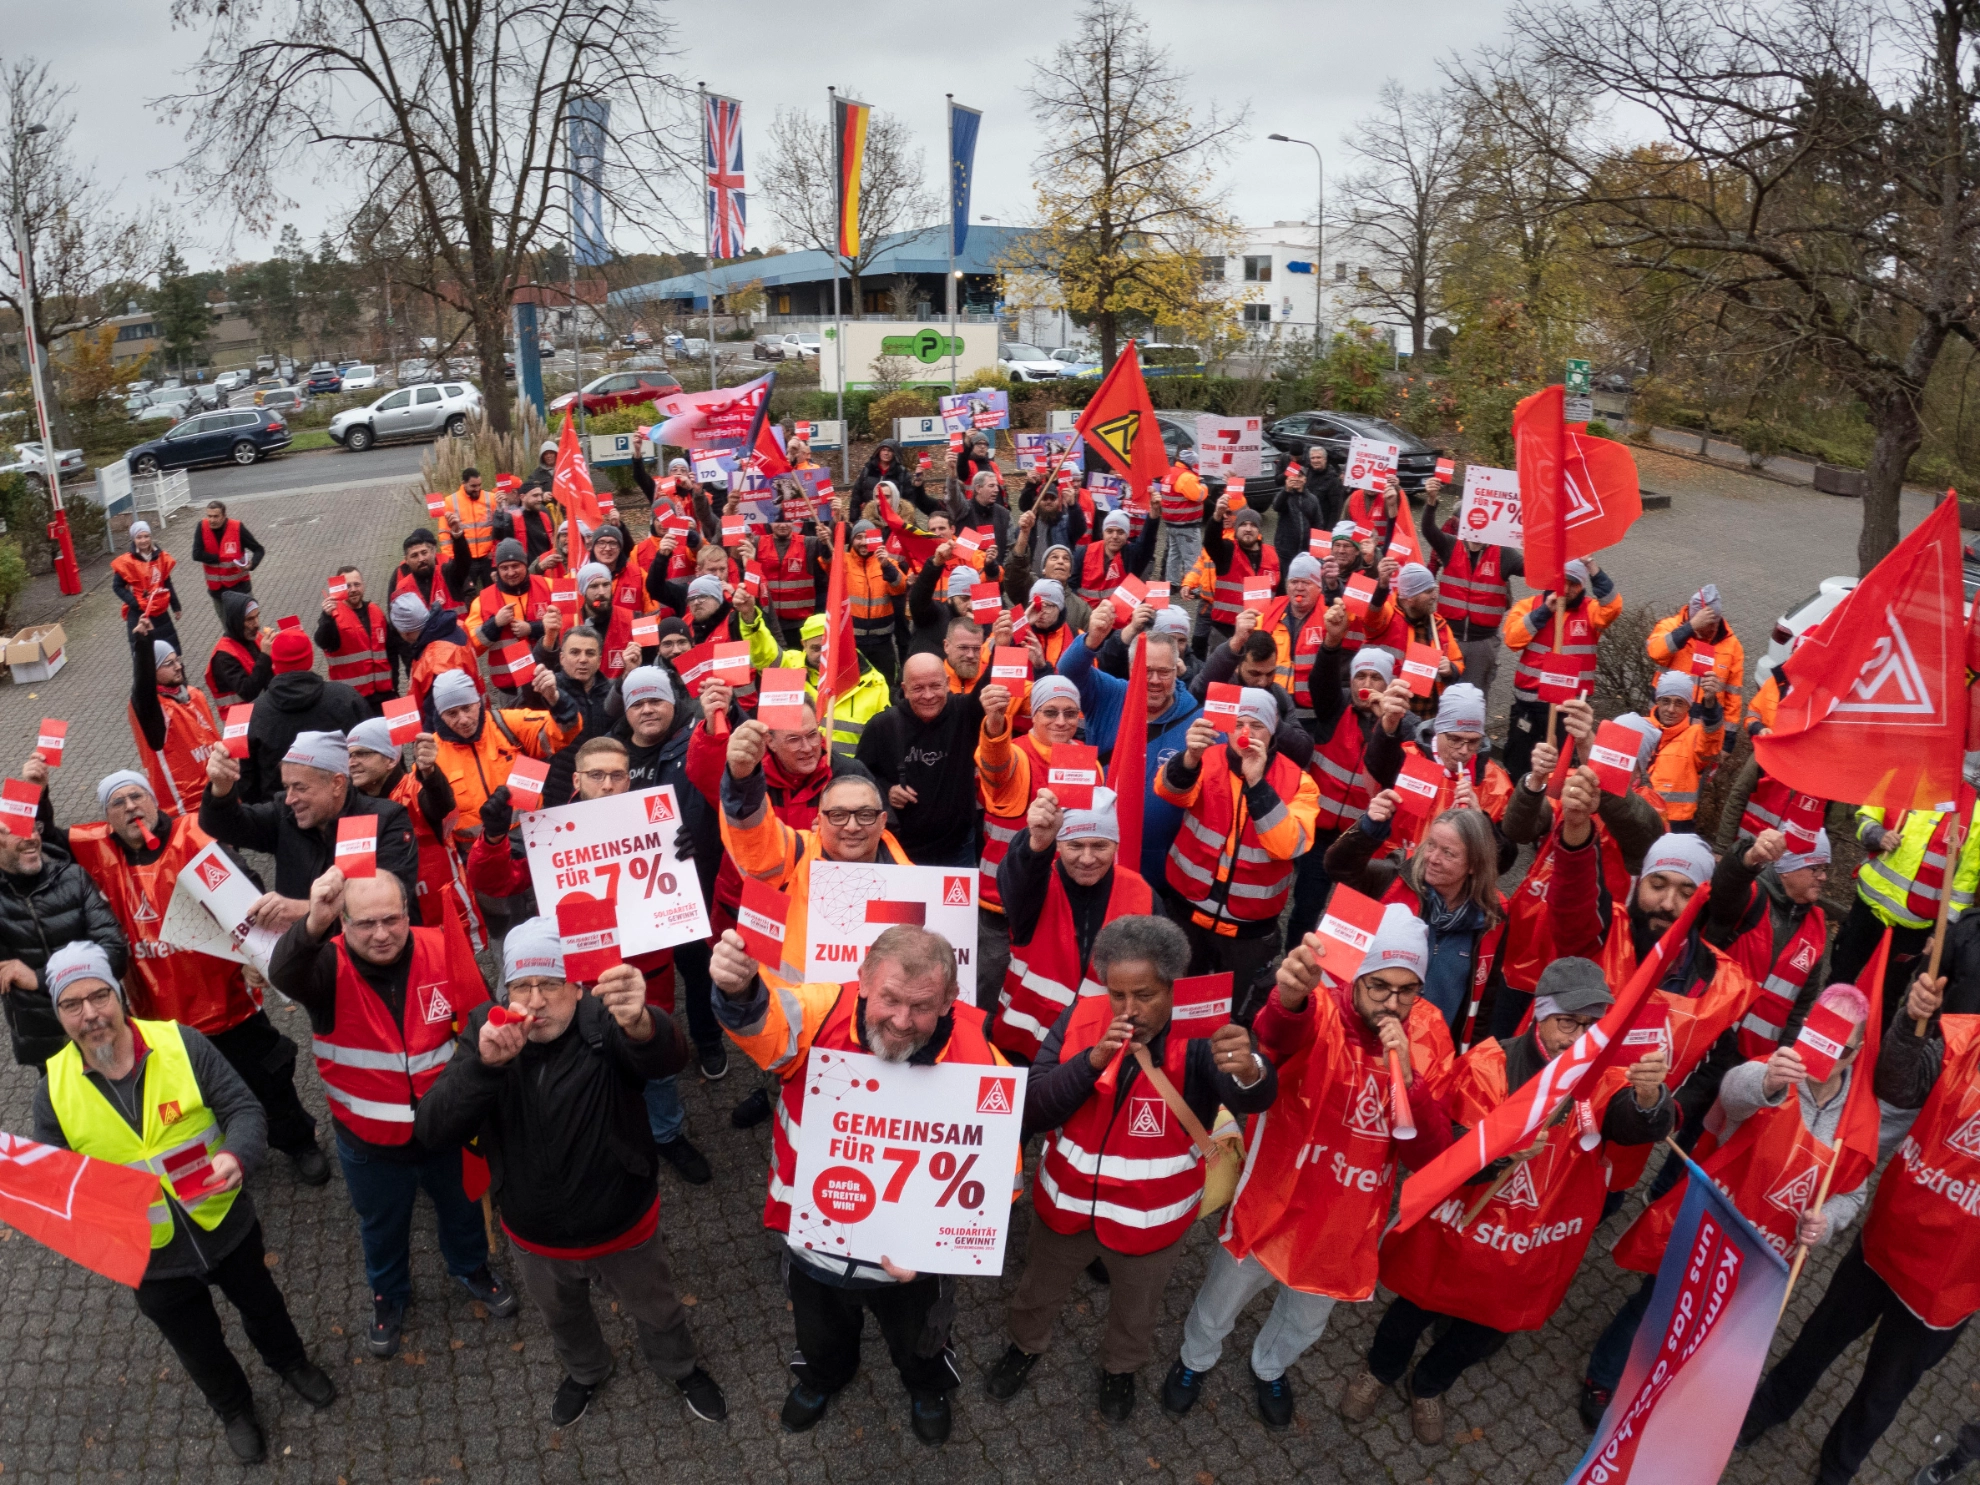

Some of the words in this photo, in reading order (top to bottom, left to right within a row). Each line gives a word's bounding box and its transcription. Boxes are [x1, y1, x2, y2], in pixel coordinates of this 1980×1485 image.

[1201, 443, 1217, 451] ZUM
[1218, 444, 1259, 452] FAIRLIEBEN
[700, 470, 716, 479] 170
[1473, 496, 1489, 507] FÜR
[1490, 500, 1504, 521] 7
[552, 831, 662, 869] GEMEINSAM
[555, 867, 590, 889] FÜR
[594, 862, 621, 906] 7
[628, 852, 677, 900] %
[653, 902, 697, 919] SOLIDARITÄT
[667, 910, 698, 923] GEWINNT
[814, 943, 858, 962] ZUM
[832, 1111, 983, 1146] GEMEINSAM
[829, 1135, 875, 1164] FÜR
[881, 1146, 921, 1204] 7
[928, 1151, 986, 1210] %
[821, 1189, 867, 1202] STREITEN
[828, 1180, 860, 1192] DAFÜR
[1915, 1167, 1980, 1217] streik
[832, 1200, 855, 1211] WIR!
[938, 1226, 997, 1237] SOLIDARITÄT
[954, 1236, 996, 1246] GEWINNT
[1473, 1217, 1583, 1254] streiken
[1690, 1223, 1715, 1284] uns
[1668, 1290, 1694, 1352] das
